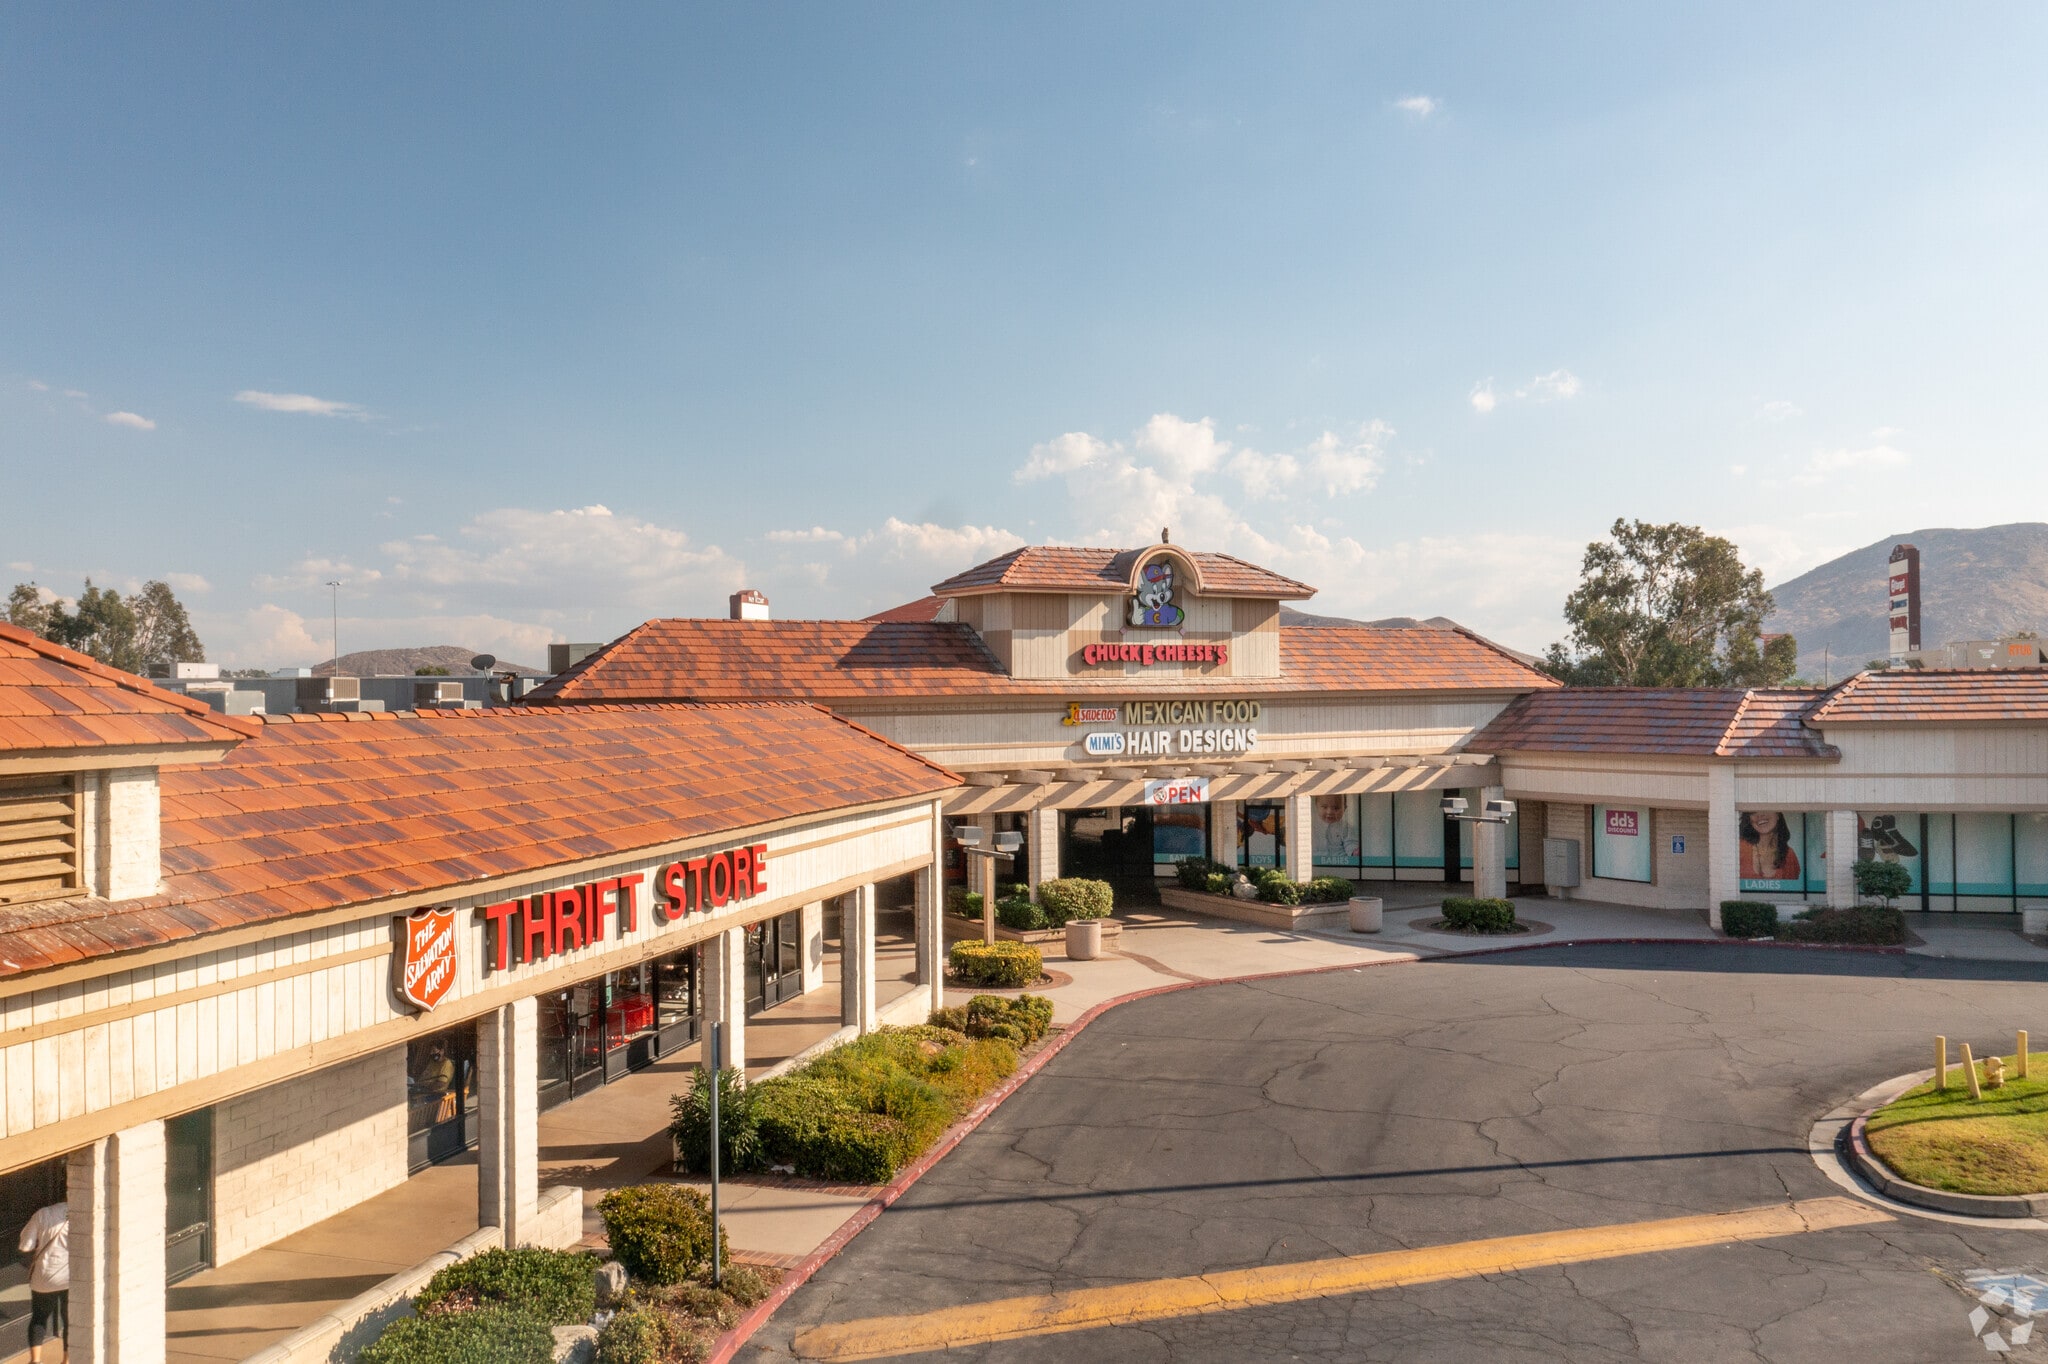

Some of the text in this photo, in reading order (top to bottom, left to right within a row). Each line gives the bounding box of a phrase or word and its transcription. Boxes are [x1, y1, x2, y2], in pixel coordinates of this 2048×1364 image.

[1084, 644, 1228, 666] CHUCK E CHEESE'S
[1125, 701, 1206, 724] MEXICAN
[1213, 701, 1260, 722] FOOD
[1089, 728, 1257, 754] MIMI'S HAIR DESIGNS
[1607, 827, 1637, 835] DISCOUNTS
[1610, 812, 1634, 828] dd's
[1251, 855, 1273, 864] TOYS
[1321, 856, 1349, 865] BABIES
[1745, 880, 1781, 889] LADIES
[486, 843, 767, 971] THRIFT STORE
[414, 919, 436, 953] THE
[407, 921, 452, 989] SALVATION
[424, 950, 451, 999] ARMY
